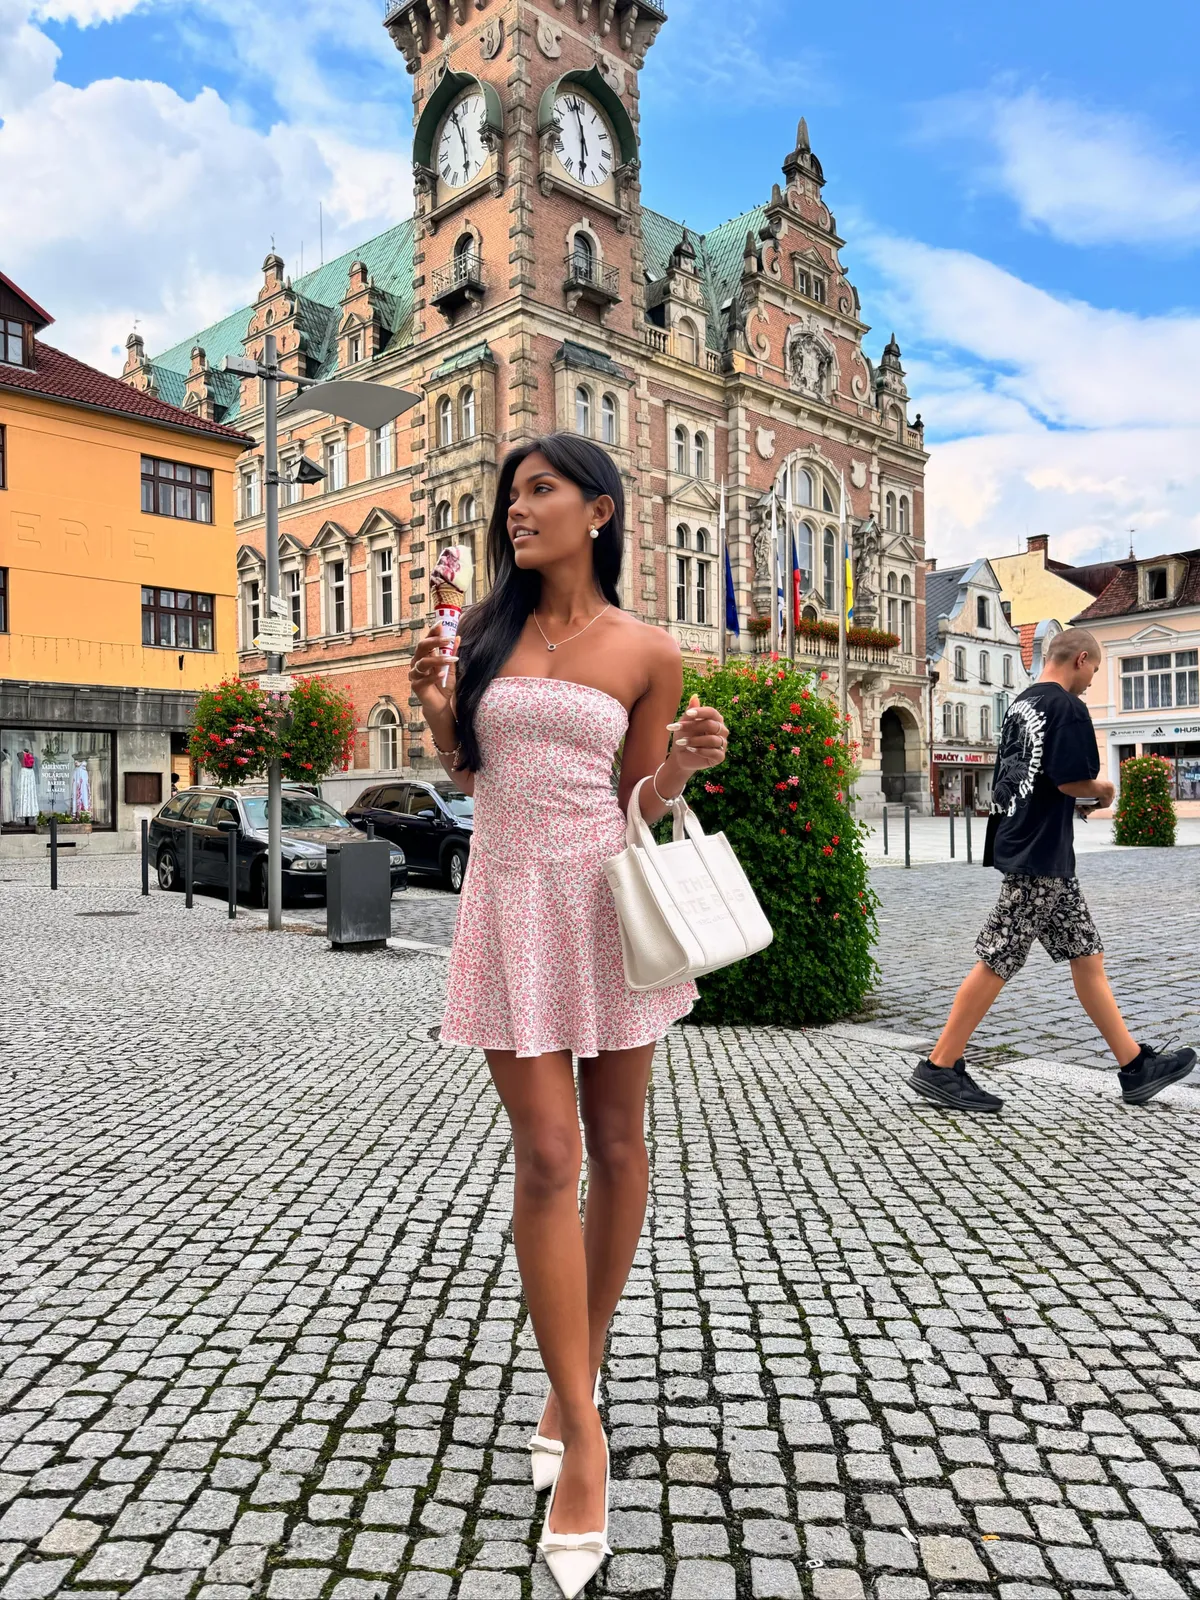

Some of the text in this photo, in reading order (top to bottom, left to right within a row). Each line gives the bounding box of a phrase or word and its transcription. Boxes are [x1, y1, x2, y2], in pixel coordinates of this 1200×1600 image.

[934, 752, 959, 761] HRAČKY
[965, 753, 982, 762] DÁRKY
[677, 875, 713, 894] THE
